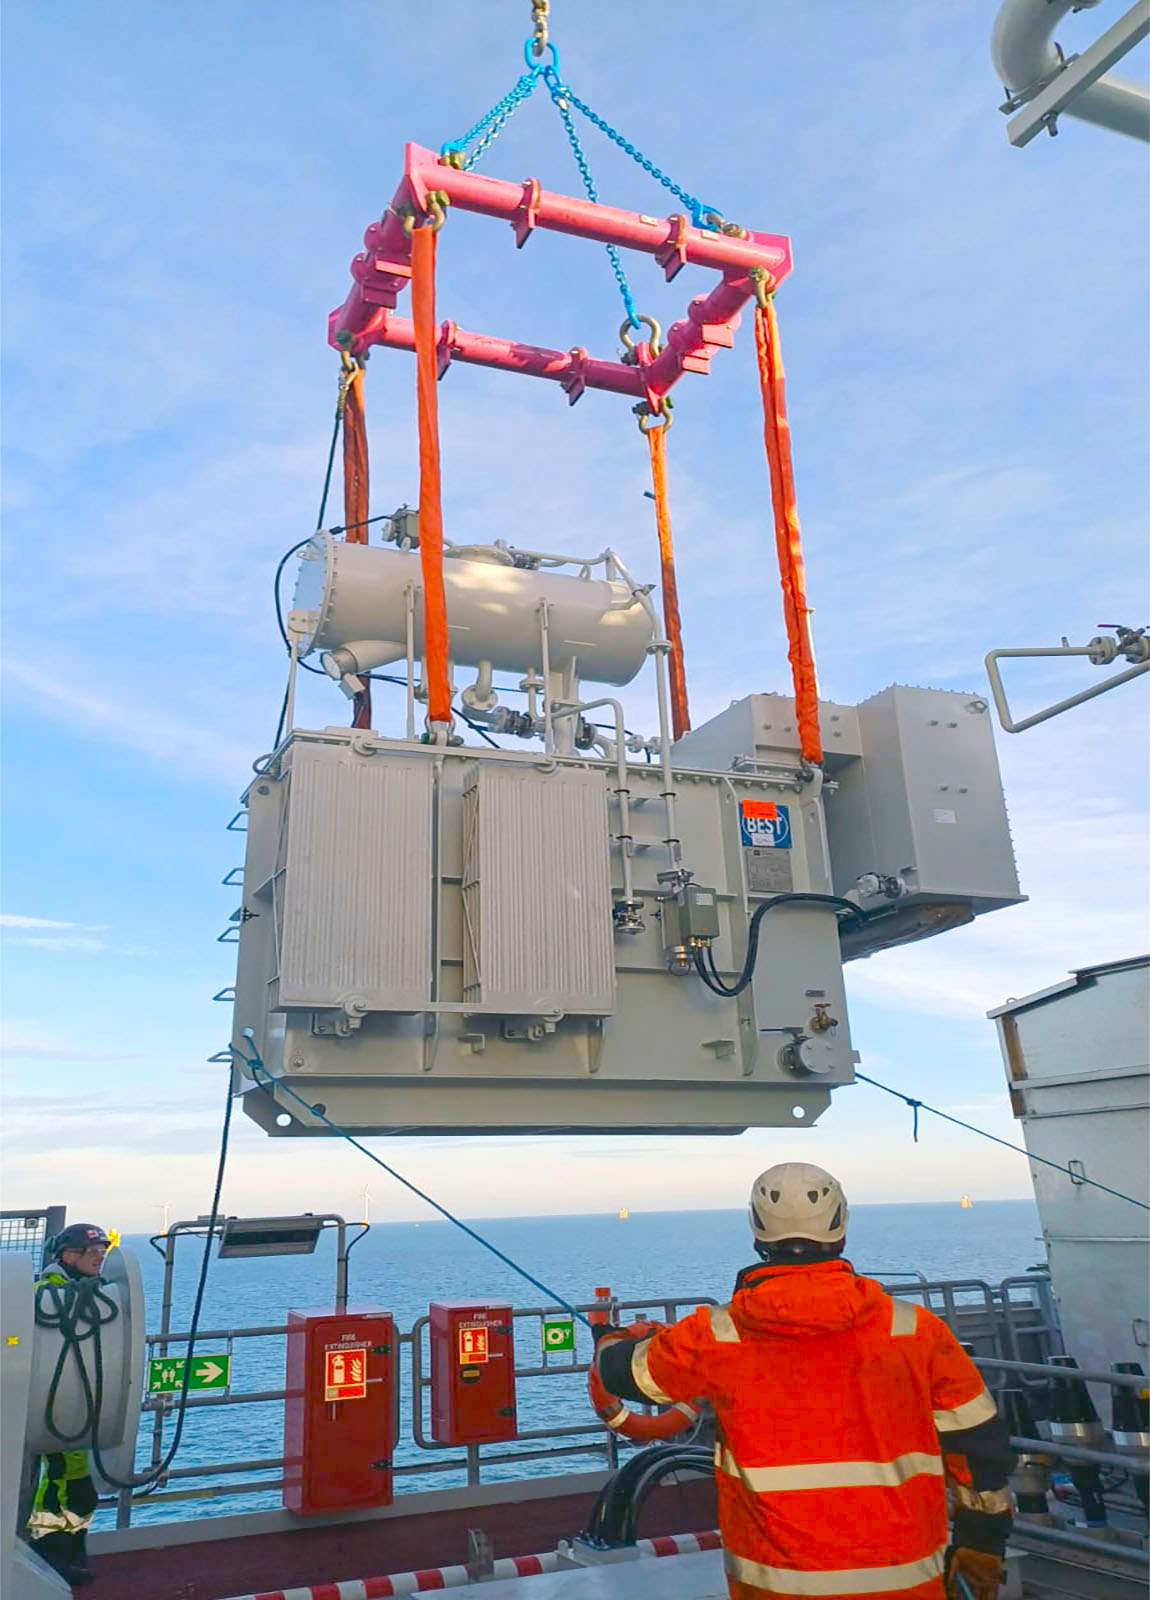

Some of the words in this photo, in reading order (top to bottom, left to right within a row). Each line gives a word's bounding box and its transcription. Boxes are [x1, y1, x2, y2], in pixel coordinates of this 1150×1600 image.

[747, 816, 783, 835] BEST
[473, 1312, 488, 1320] FIRE
[341, 1333, 356, 1341] FIRE
